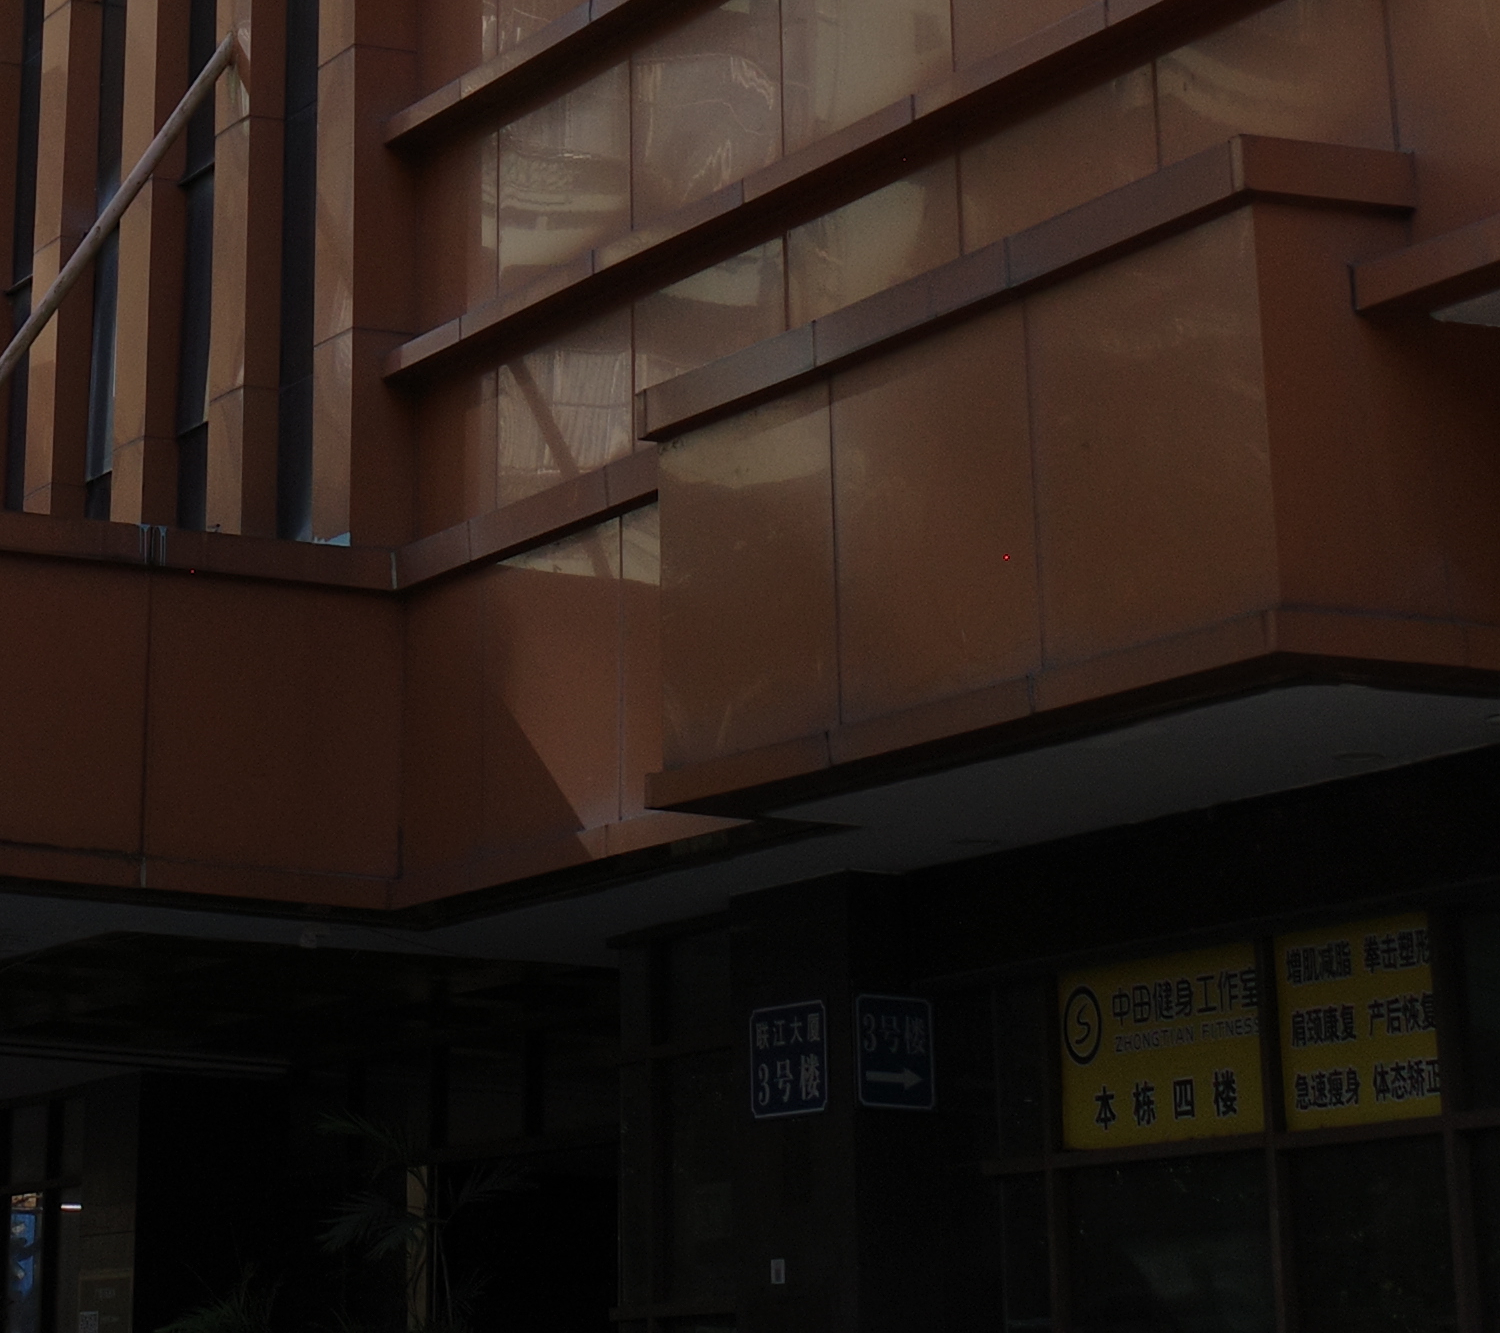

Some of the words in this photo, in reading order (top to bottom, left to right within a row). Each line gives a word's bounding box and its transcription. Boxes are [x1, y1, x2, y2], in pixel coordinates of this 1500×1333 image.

[1286, 940, 1351, 984] 增肌减脂
[1363, 928, 1430, 974] 拳击塑形
[1112, 967, 1259, 1026] 中田健身工作室
[1291, 1003, 1357, 1047] 肩颈康复
[1367, 991, 1437, 1037] 产后恢复
[862, 1013, 926, 1055] 3号楼
[1115, 1025, 1195, 1053] ZHONGTIAN
[757, 1053, 821, 1106] 3号楼
[1094, 1069, 1238, 1131] 本栋四楼
[1294, 1067, 1361, 1110] 急速瘦身
[1373, 1059, 1441, 1103] 体态矫正
